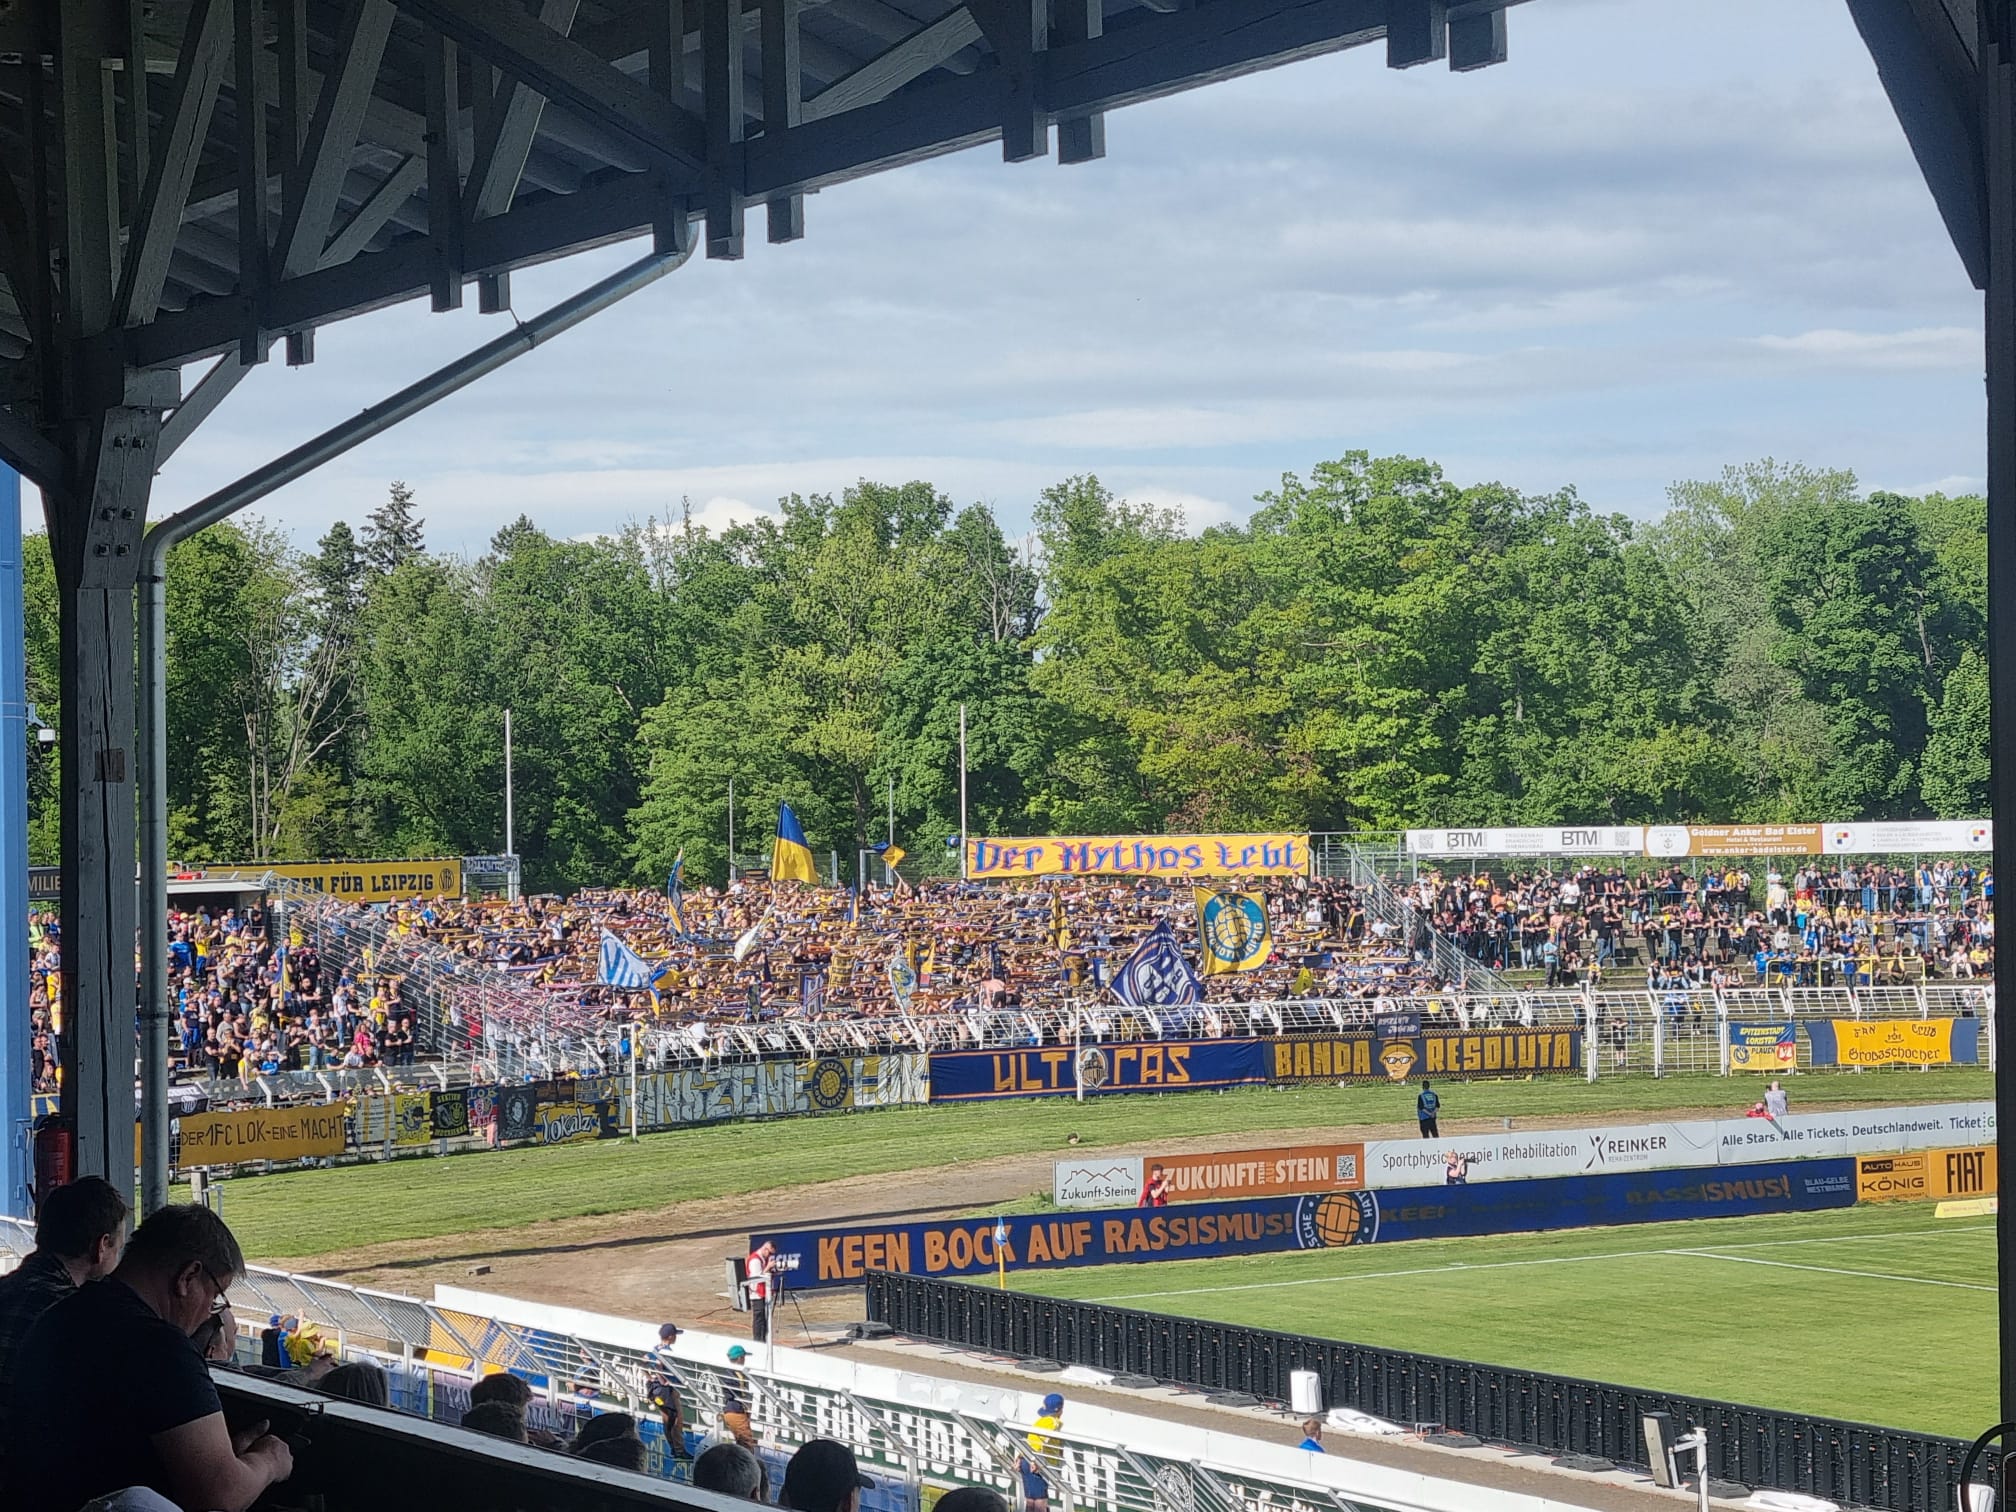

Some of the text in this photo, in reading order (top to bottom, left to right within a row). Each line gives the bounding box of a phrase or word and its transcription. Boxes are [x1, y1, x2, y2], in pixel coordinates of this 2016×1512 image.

[1447, 832, 1483, 847] BTM
[1561, 830, 1598, 846] BTM
[1691, 826, 1816, 836] Goldner Anker Bad Elster
[972, 839, 1044, 873] Der
[1052, 839, 1203, 873] Mythos
[1702, 846, 1808, 854] www.anker-badelster.de
[331, 870, 364, 893] FÜR
[371, 873, 434, 892] LEIPZIG
[1911, 1023, 1937, 1038] CLUB
[1274, 1032, 1571, 1077] BANDA RESOLUTA
[1752, 1046, 1776, 1054] PLAUEN
[181, 1131, 204, 1146] DER
[300, 1114, 344, 1140] MACHT
[1949, 1116, 1982, 1129] Ticket
[1722, 1120, 1944, 1146] Alle Stars. Alle Tickets. Deutschlandweit.
[1502, 1142, 1577, 1161] Rehabilitation
[1608, 1136, 1667, 1153] REINKER
[1163, 1161, 1257, 1192] ZUKUNFT
[1276, 1157, 1329, 1184] STEIN
[1947, 1151, 1985, 1194] FIAT
[1061, 1185, 1137, 1199] Zukunft-Steine
[1861, 1175, 1925, 1193] KÖNIG
[818, 1211, 1293, 1280] KEEN BOCK AUF RASSISMUS!
[816, 1392, 874, 1459] FÜR
